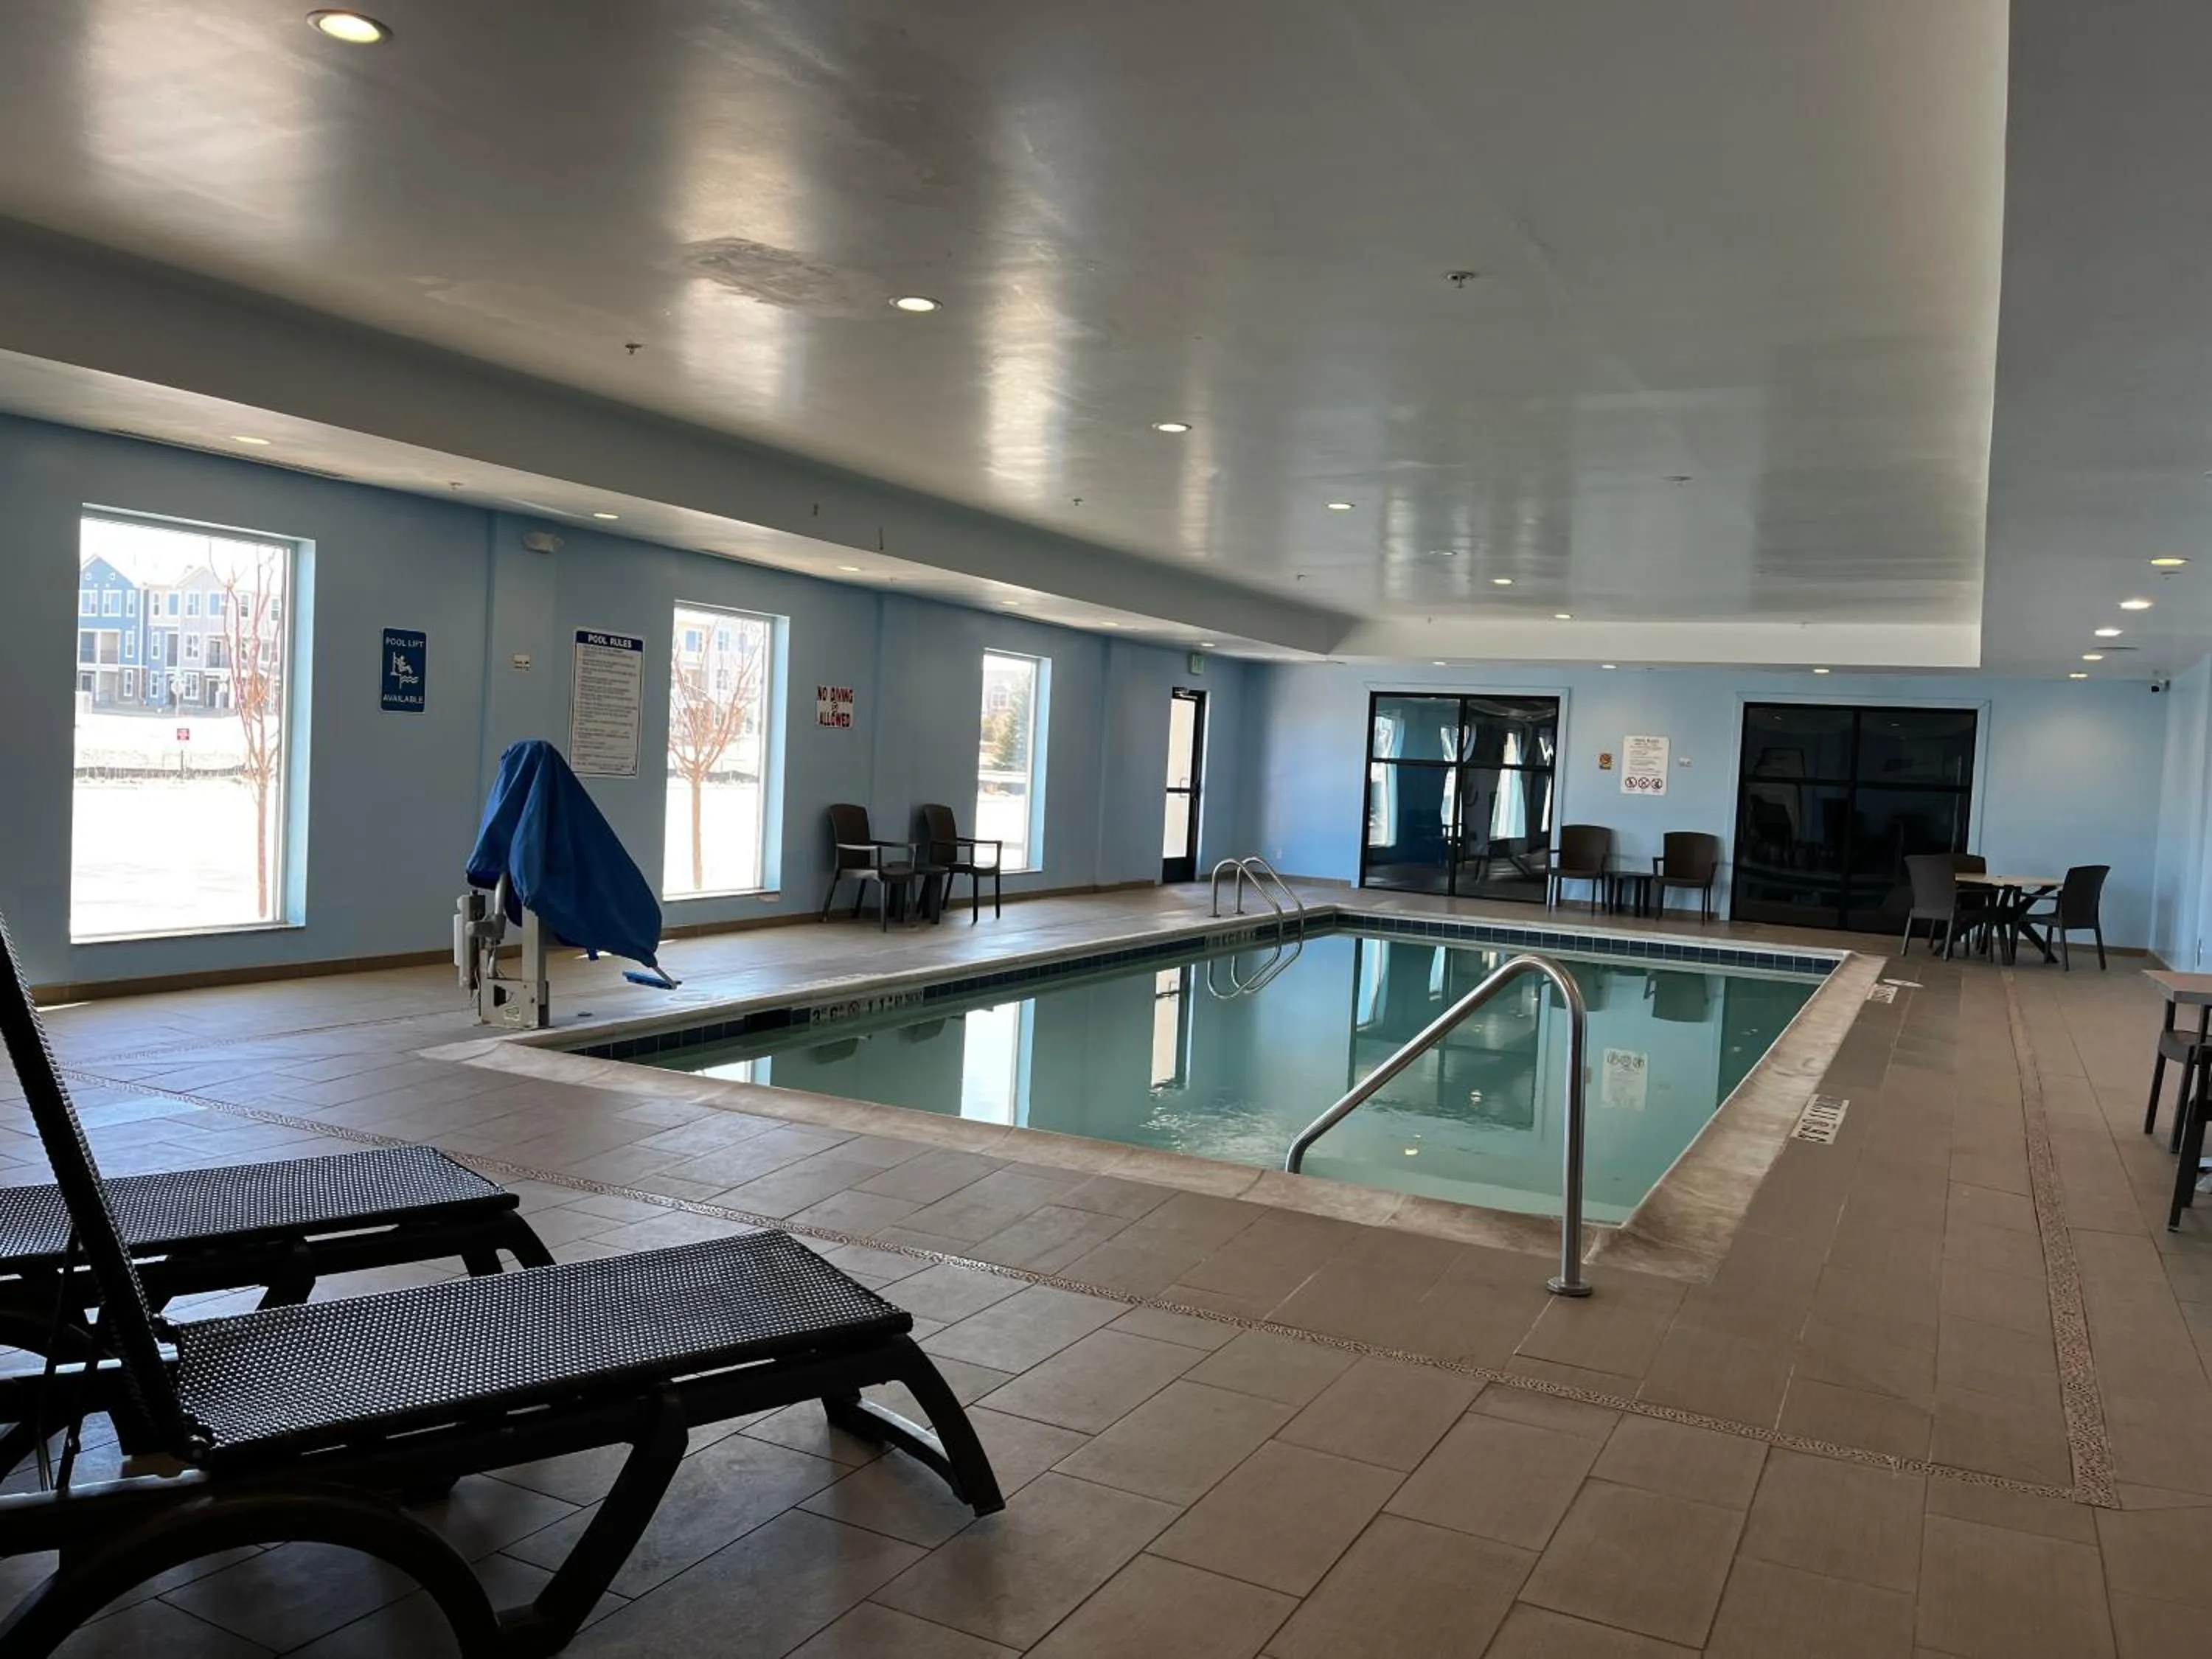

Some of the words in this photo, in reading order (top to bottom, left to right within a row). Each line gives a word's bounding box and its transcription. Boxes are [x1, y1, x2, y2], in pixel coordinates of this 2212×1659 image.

[386, 636, 406, 647] POOL
[408, 639, 425, 649] LIFT
[588, 633, 608, 645] POOL
[610, 636, 633, 648] RULES
[383, 694, 425, 704] AVAILABLE
[817, 685, 827, 700] NO
[831, 686, 853, 703] DIVING
[819, 712, 851, 728] ALLOWED
